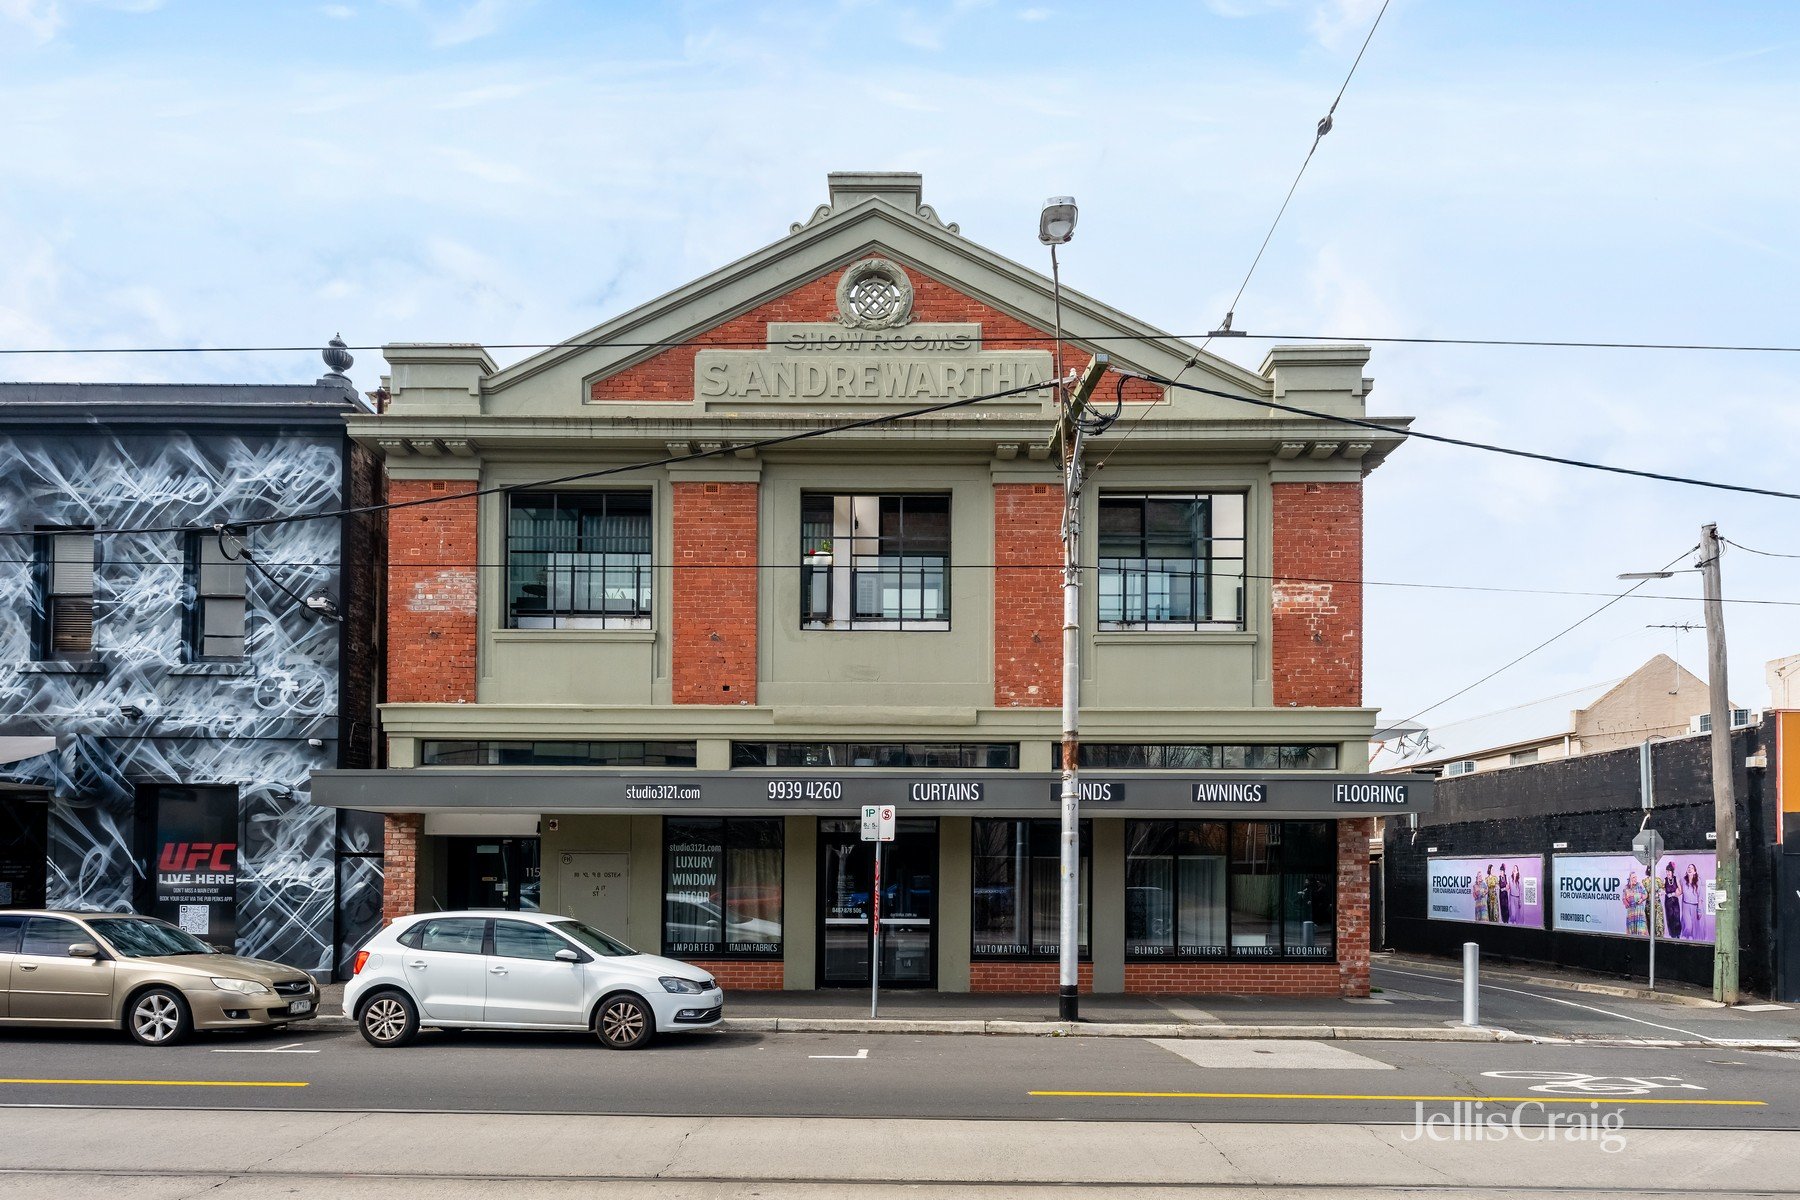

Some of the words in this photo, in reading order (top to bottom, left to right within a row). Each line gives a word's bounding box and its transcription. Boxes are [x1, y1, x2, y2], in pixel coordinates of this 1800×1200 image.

[784, 332, 865, 351] SHOW
[870, 332, 972, 350] ROOMS
[626, 785, 701, 799] studio3121.com
[768, 781, 802, 799] 9939
[806, 781, 842, 799] 4260
[912, 783, 979, 801] CURTAINS
[1197, 784, 1261, 802] AWNINGS
[1337, 785, 1404, 803] FLOORING
[865, 808, 876, 817] 1P
[669, 843, 722, 852] studio3121.com
[159, 842, 236, 871] UFC
[675, 856, 714, 868] LUXURY
[525, 867, 541, 877] 115
[158, 874, 191, 884] LIVE
[195, 874, 235, 884] HERE
[672, 874, 717, 886] WINDOW
[1432, 875, 1460, 888] FROCK
[1460, 876, 1472, 888] UP
[1560, 876, 1601, 892] FROCK
[1603, 877, 1621, 892] UP
[678, 891, 710, 903] DECOR
[1571, 892, 1596, 900] OVARIAN
[1596, 893, 1621, 901] CANCER
[673, 943, 715, 952] IMPORTED
[729, 943, 752, 952] ITALIAN
[752, 943, 778, 952] FABRICS
[975, 945, 1028, 954] AUTOMATION
[1134, 946, 1164, 955] BLINDS
[1181, 946, 1222, 955] SHUTTERS
[1236, 946, 1274, 955] AWNINGS
[1287, 947, 1328, 955] FLOORING
